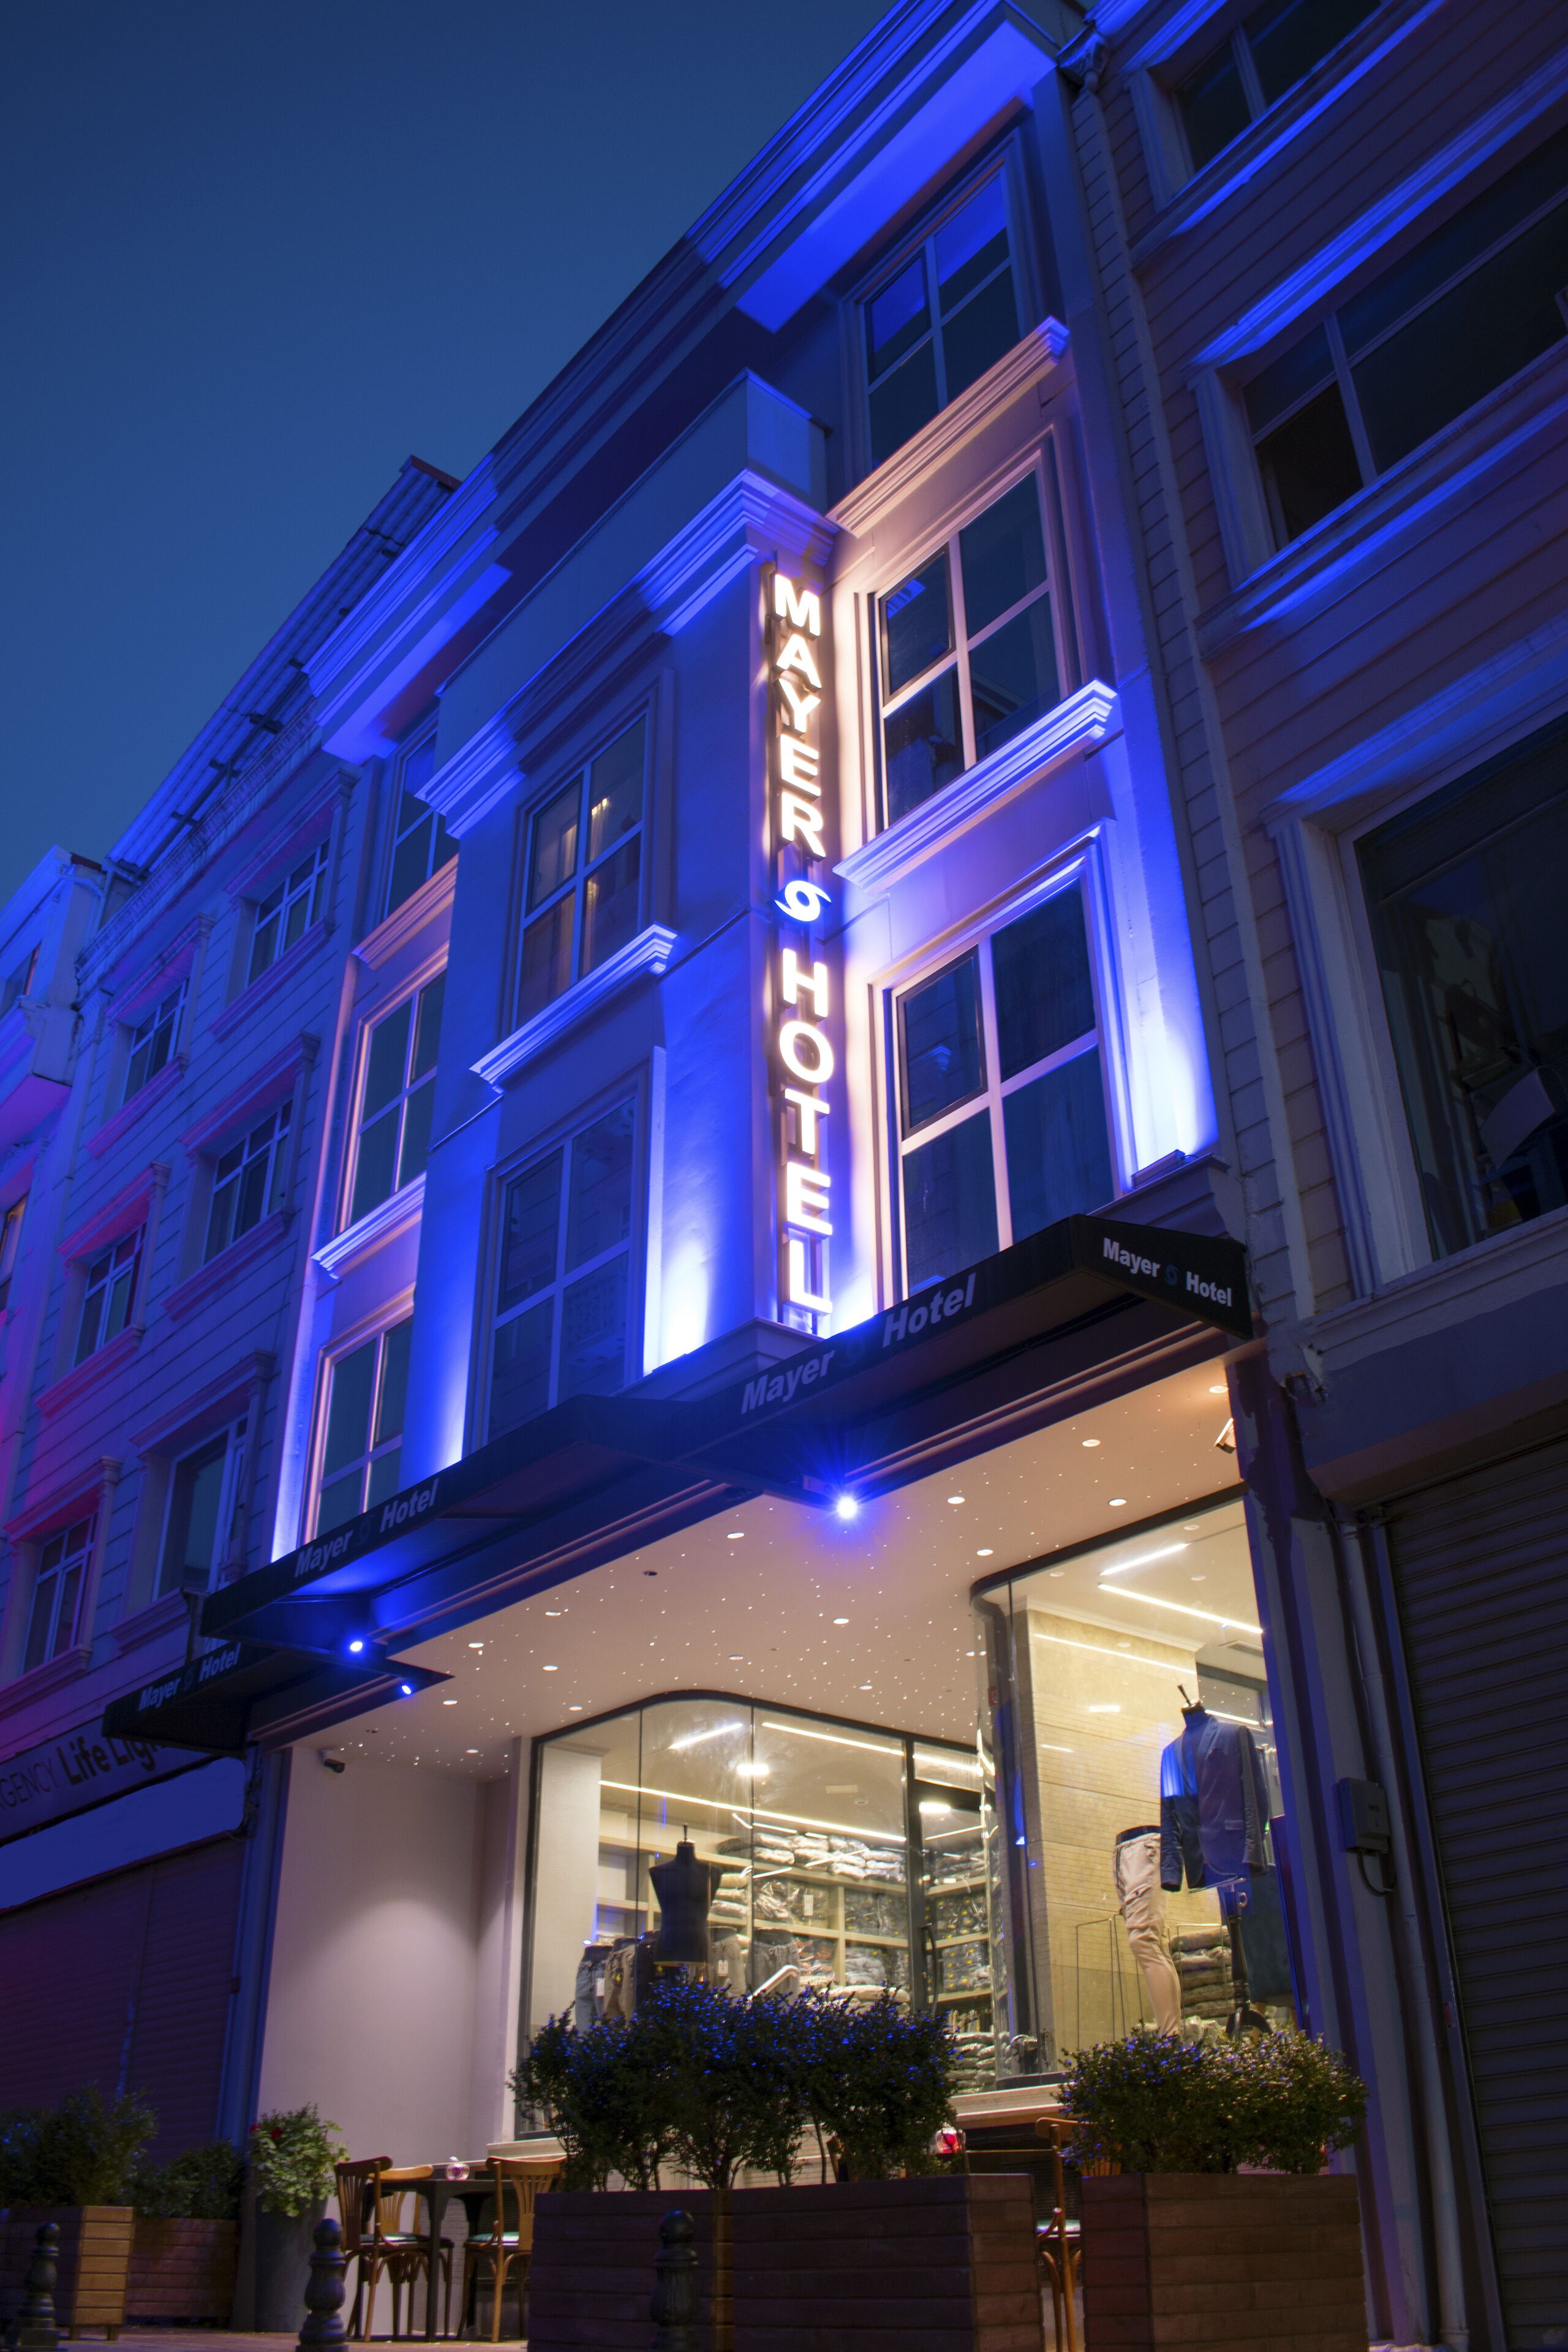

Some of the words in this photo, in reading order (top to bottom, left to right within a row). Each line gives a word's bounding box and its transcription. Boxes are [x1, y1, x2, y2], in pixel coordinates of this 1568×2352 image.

[774, 573, 826, 859] MAYER
[778, 948, 834, 1315] HOTEL
[1103, 1237, 1161, 1278] Mayer
[1185, 1270, 1232, 1308] Hotel
[741, 1349, 835, 1415] Mayer
[882, 1272, 977, 1348] Hotel
[294, 1530, 353, 1578] Mayer
[379, 1477, 440, 1533] Hotel
[137, 1676, 182, 1712] Mayer
[198, 1642, 242, 1683] Hotel
[0, 1757, 58, 1810] GENCY
[56, 1736, 111, 1785] Life
